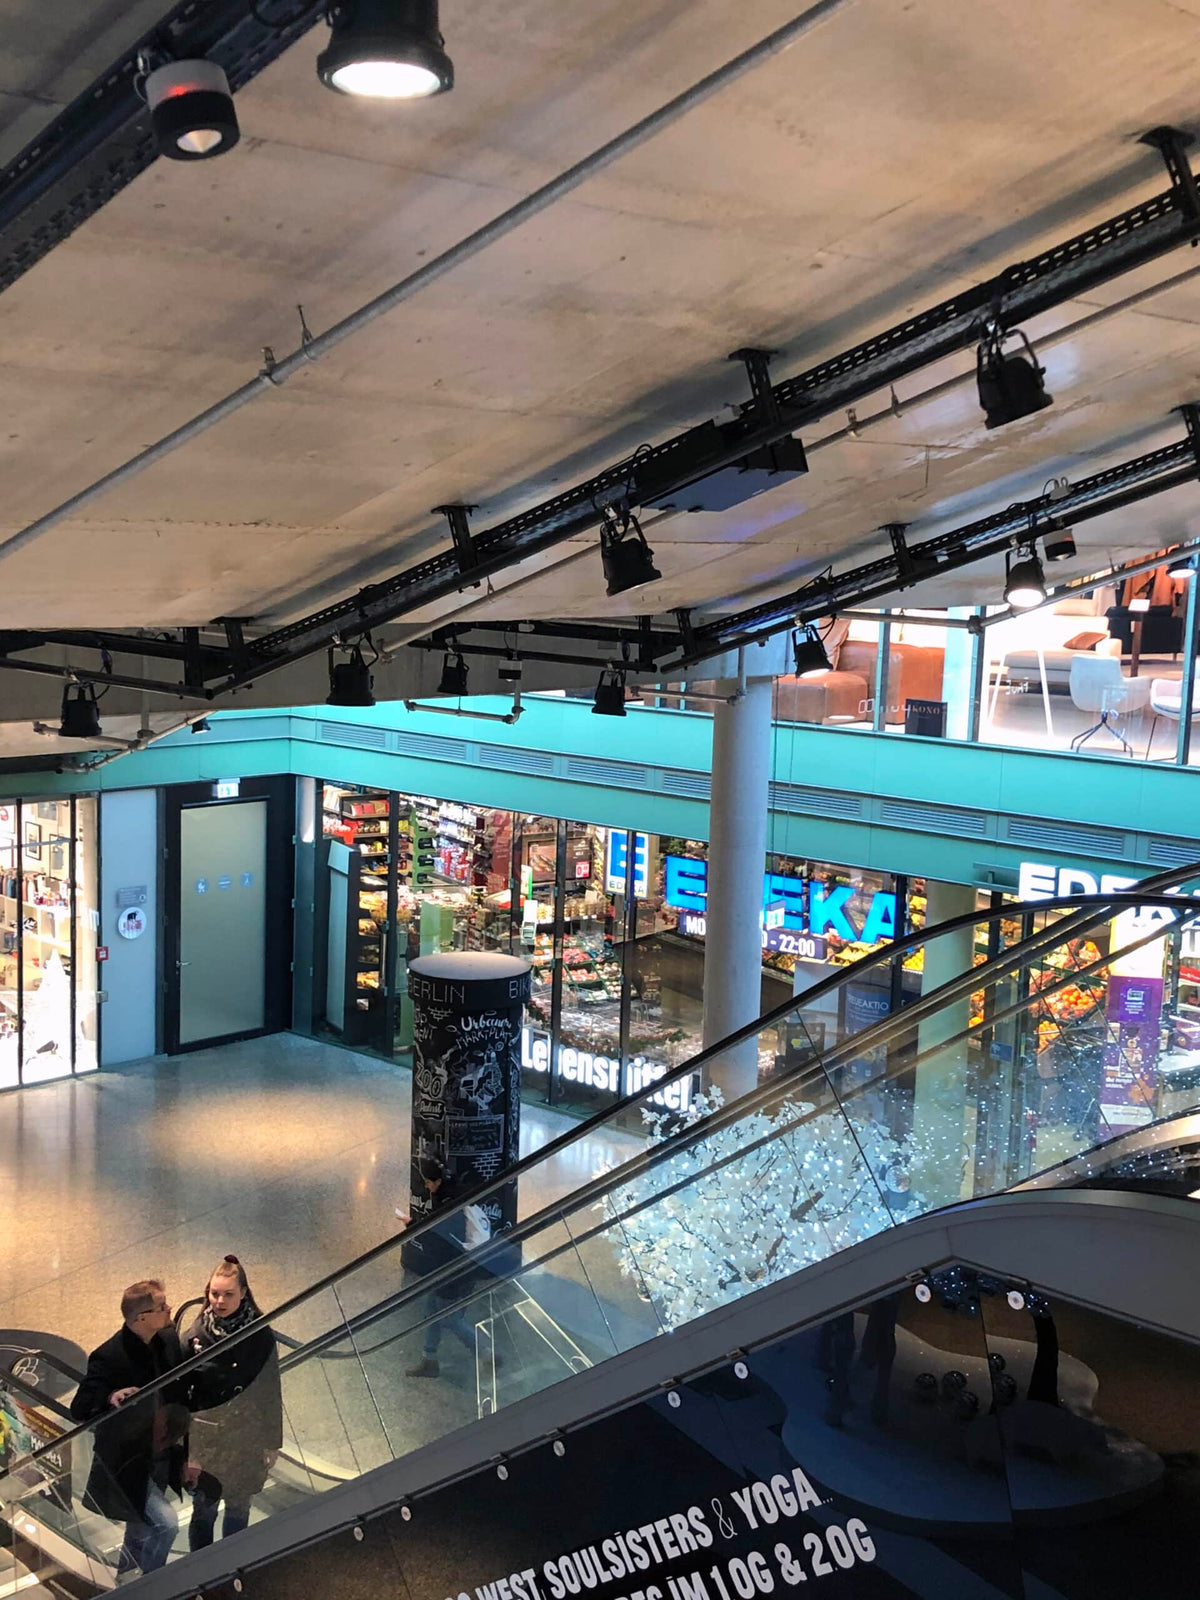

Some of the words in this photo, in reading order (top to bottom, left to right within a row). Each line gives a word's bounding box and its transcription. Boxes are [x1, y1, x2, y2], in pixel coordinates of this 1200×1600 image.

[609, 880, 644, 894] EDA
[666, 855, 897, 944] EEKA
[779, 934, 816, 958] 22:00
[509, 978, 531, 999] BIK
[711, 1498, 738, 1539] &
[774, 1542, 807, 1586] &
